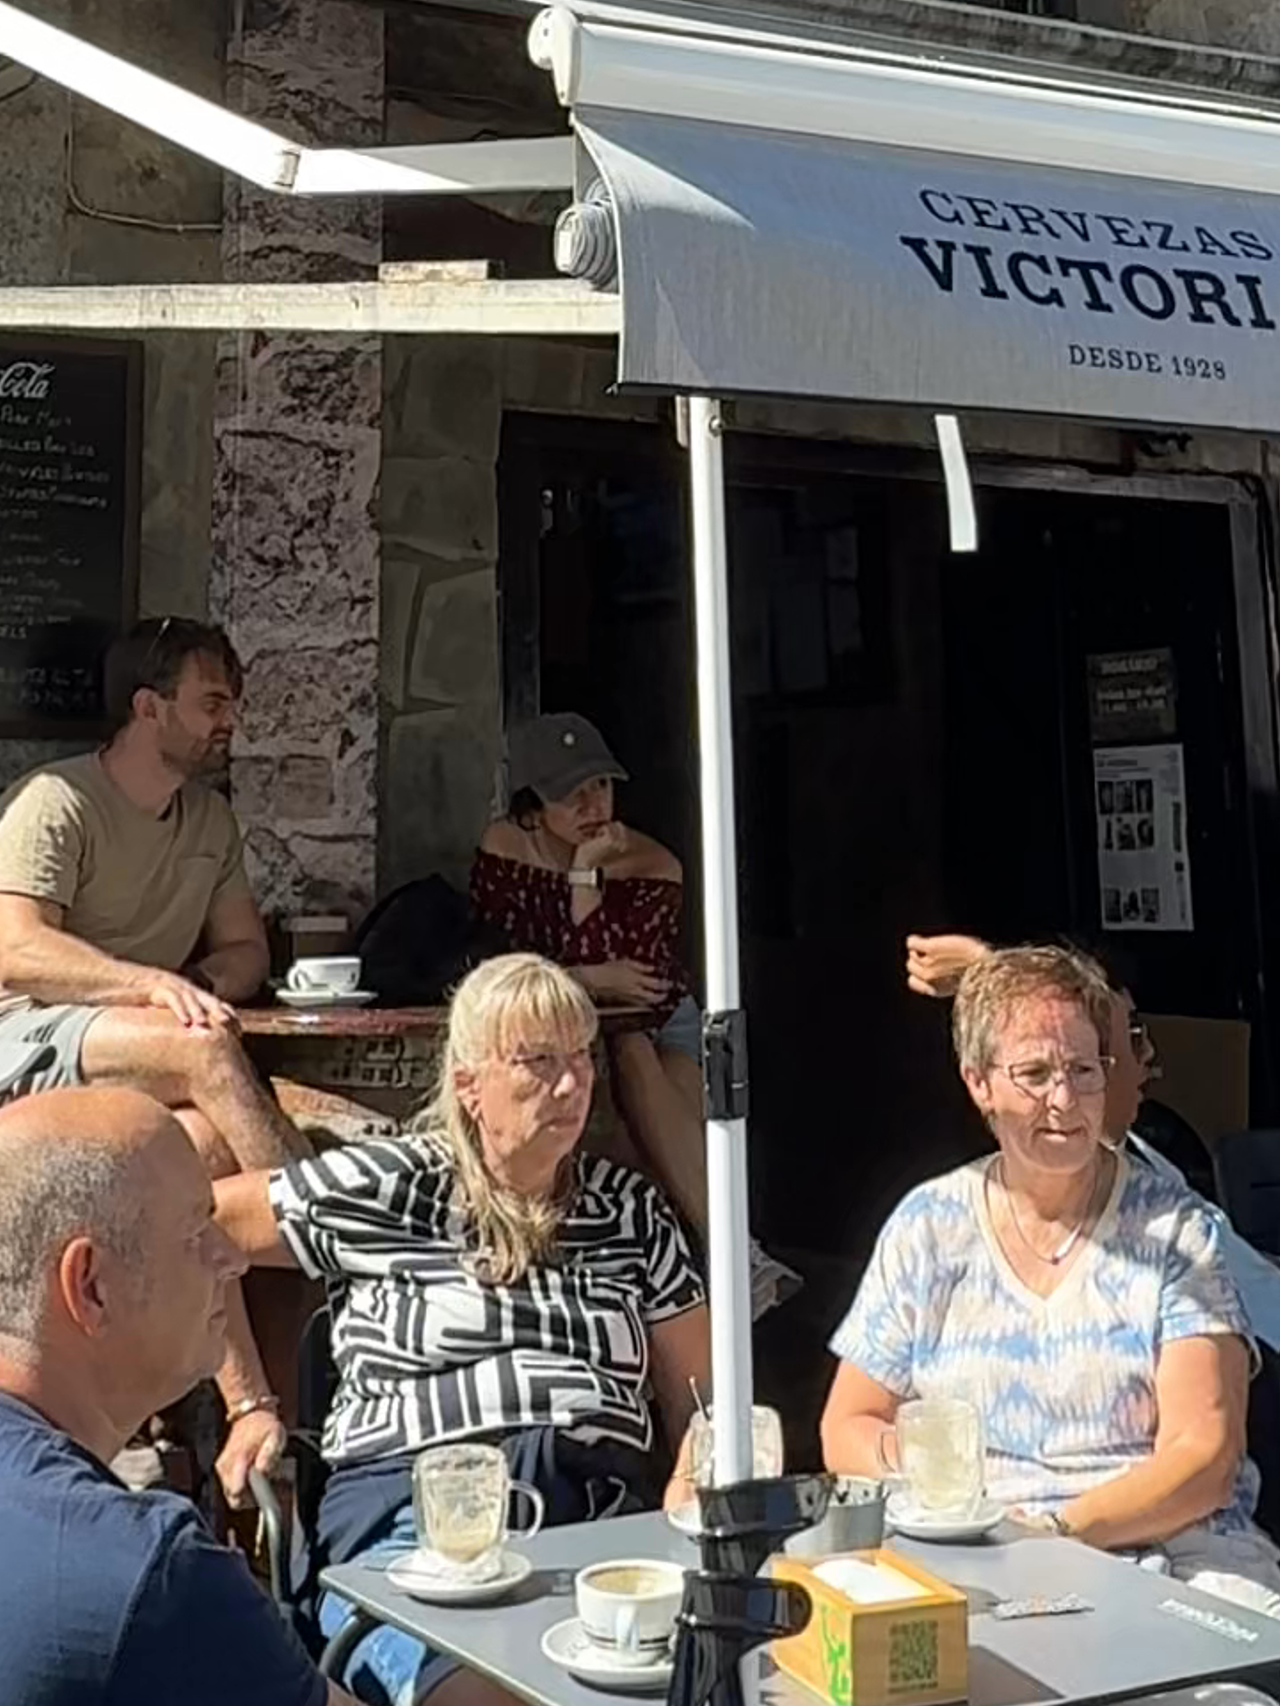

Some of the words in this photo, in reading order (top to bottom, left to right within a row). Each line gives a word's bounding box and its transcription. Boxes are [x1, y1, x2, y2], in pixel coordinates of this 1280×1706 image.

[919, 188, 1274, 262] CERVEZAS
[1067, 344, 1162, 374] DESDE
[1171, 356, 1226, 381] 1928
